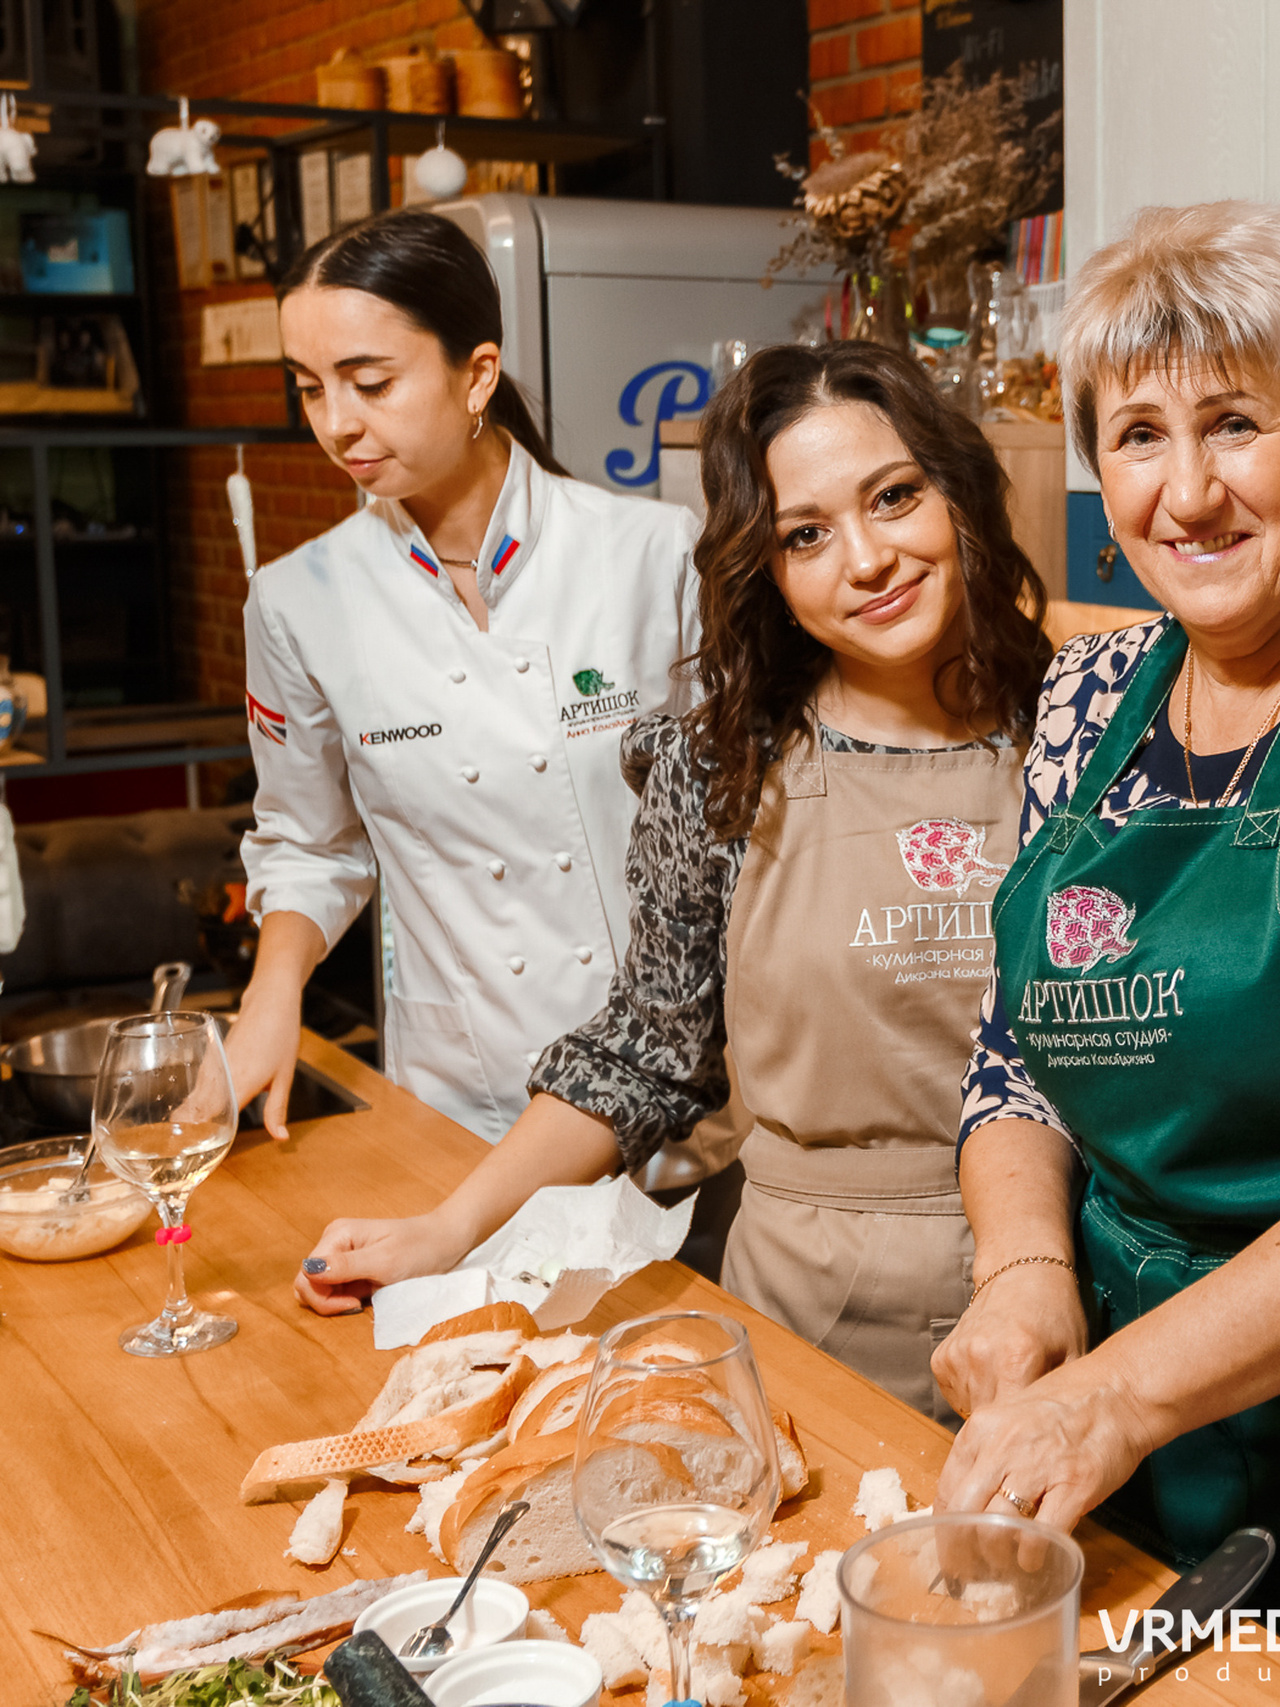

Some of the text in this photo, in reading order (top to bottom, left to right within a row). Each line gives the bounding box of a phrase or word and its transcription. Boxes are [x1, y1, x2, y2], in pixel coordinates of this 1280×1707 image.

[560, 690, 640, 722] АРТИШОК
[359, 723, 442, 746] KENWOOD
[894, 970, 951, 985] Дикрана
[1018, 965, 1185, 1024] АРТИШОК
[1047, 1053, 1091, 1068] Дикрана
